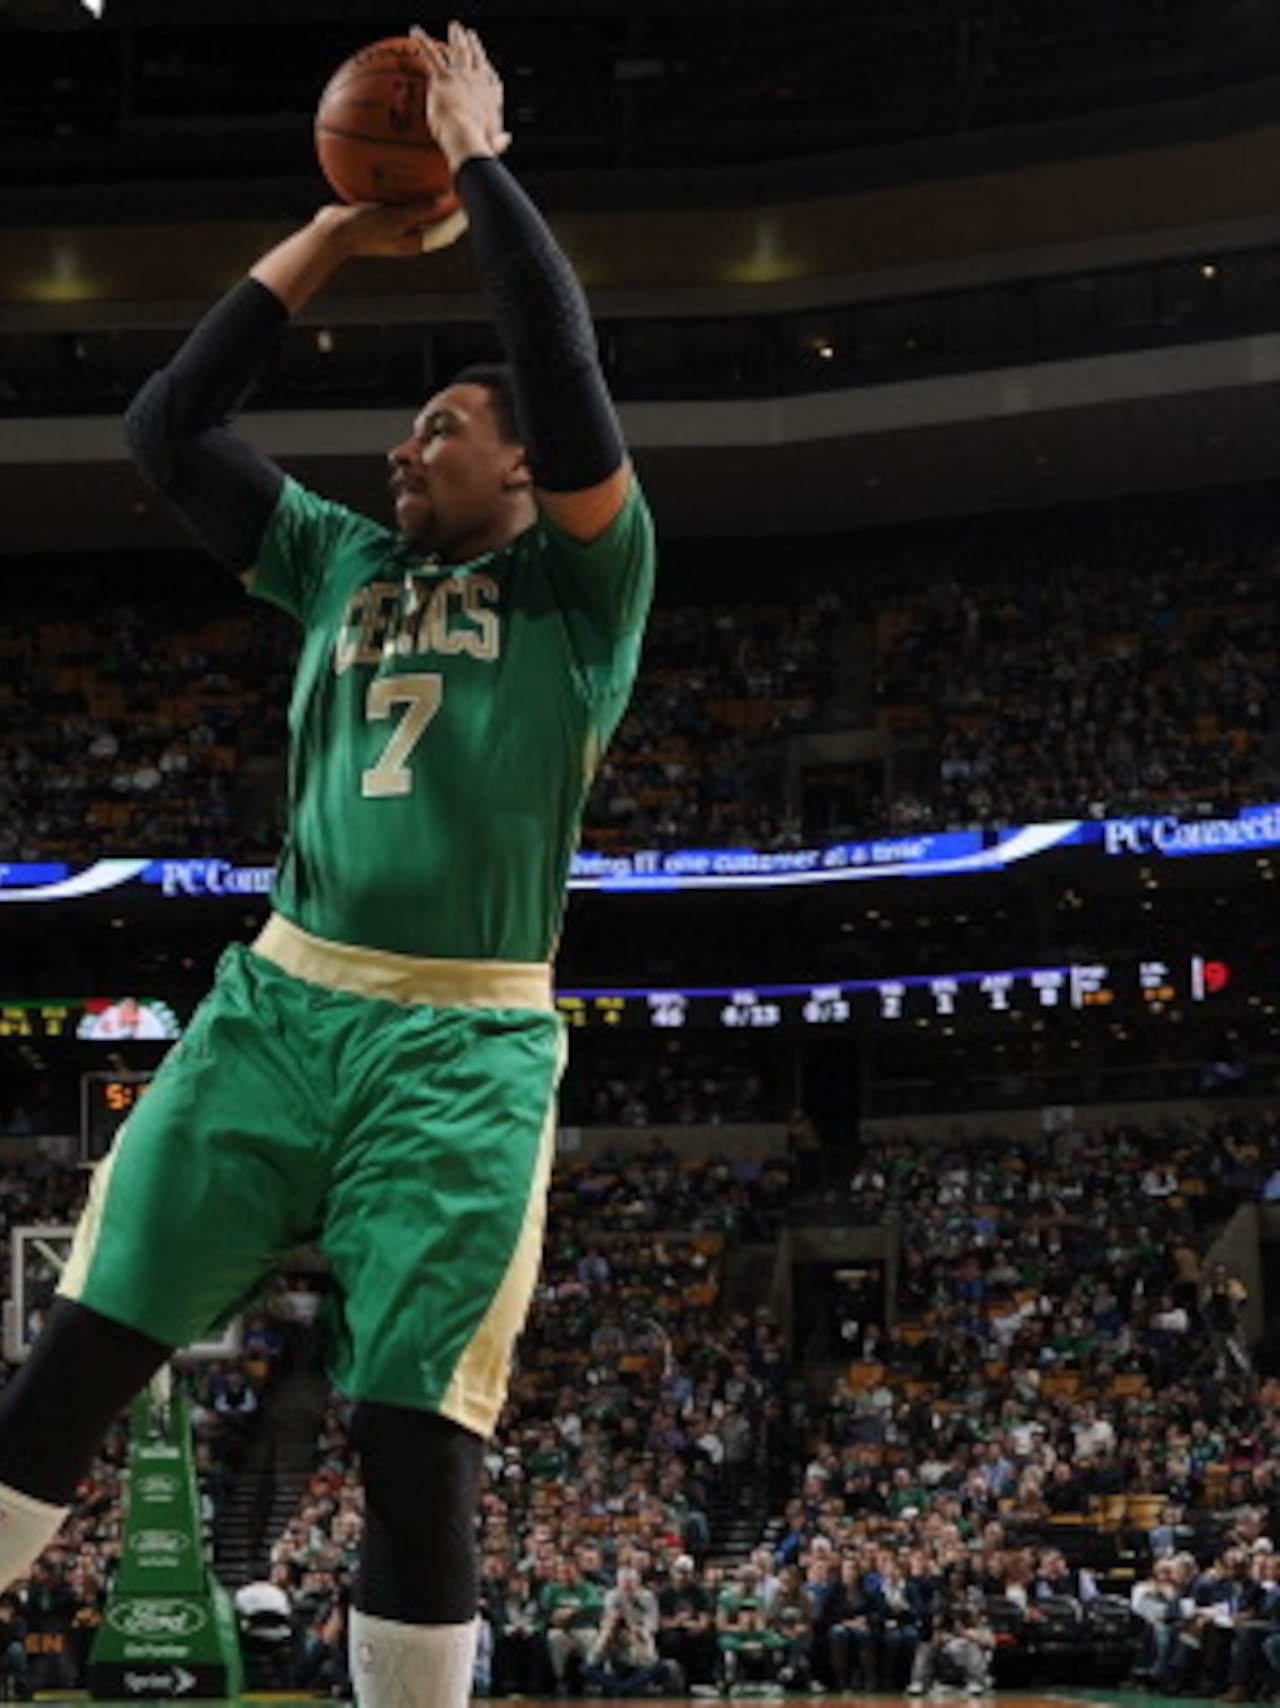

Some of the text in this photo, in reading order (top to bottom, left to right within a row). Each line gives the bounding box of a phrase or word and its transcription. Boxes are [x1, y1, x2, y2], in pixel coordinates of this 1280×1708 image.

[361, 673, 443, 798] 7
[1105, 818, 1150, 854] PC
[162, 860, 205, 896] PC
[123, 1603, 189, 1634] Ford
